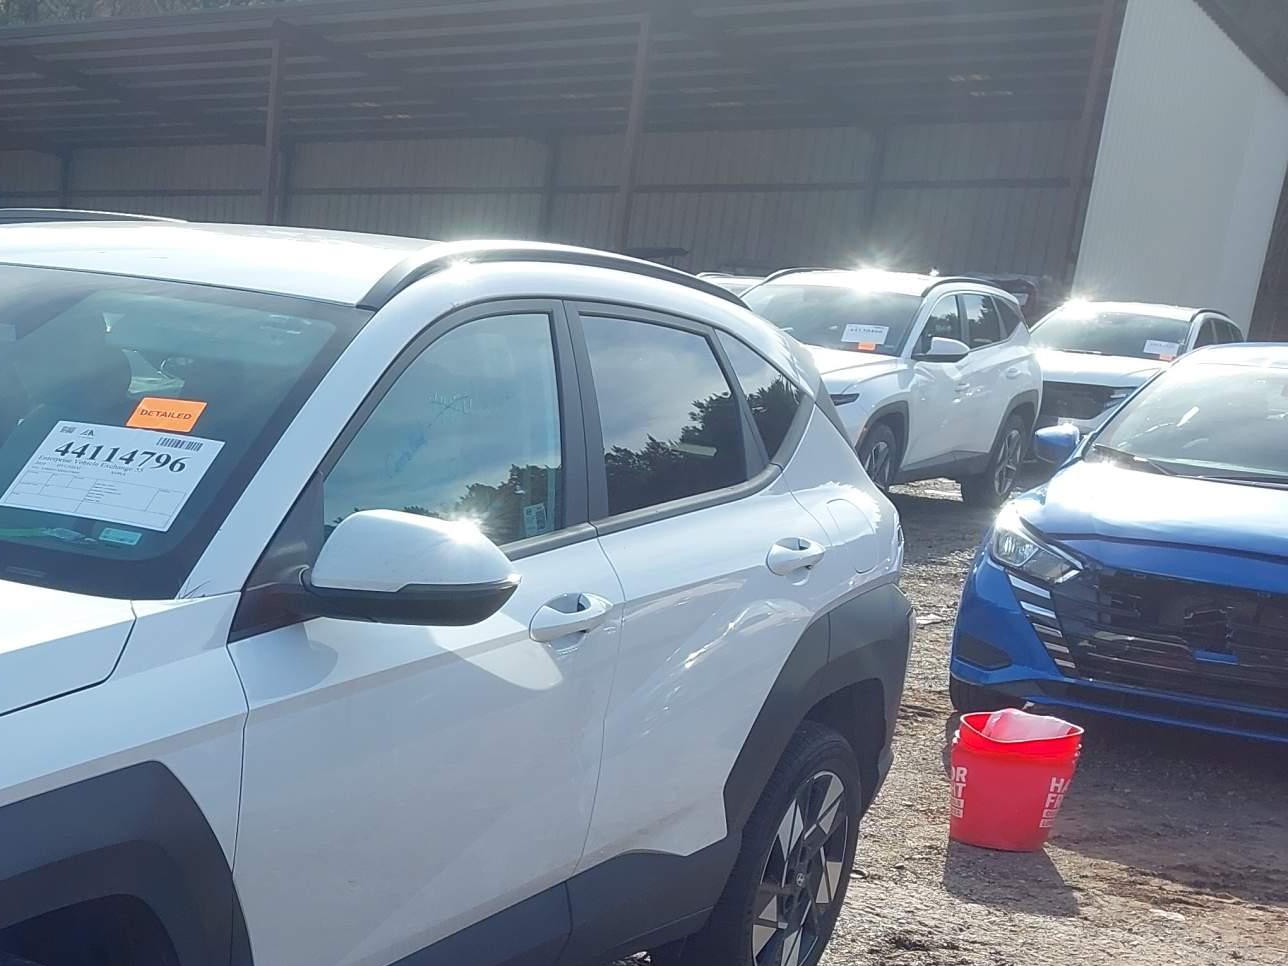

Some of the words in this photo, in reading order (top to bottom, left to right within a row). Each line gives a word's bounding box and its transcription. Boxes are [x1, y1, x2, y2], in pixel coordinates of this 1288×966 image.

[139, 408, 192, 420] DETAILED
[38, 454, 72, 464] Enterprise
[74, 458, 99, 467] Vehicle
[100, 462, 134, 472] Exchange
[54, 440, 188, 473] 44114796
